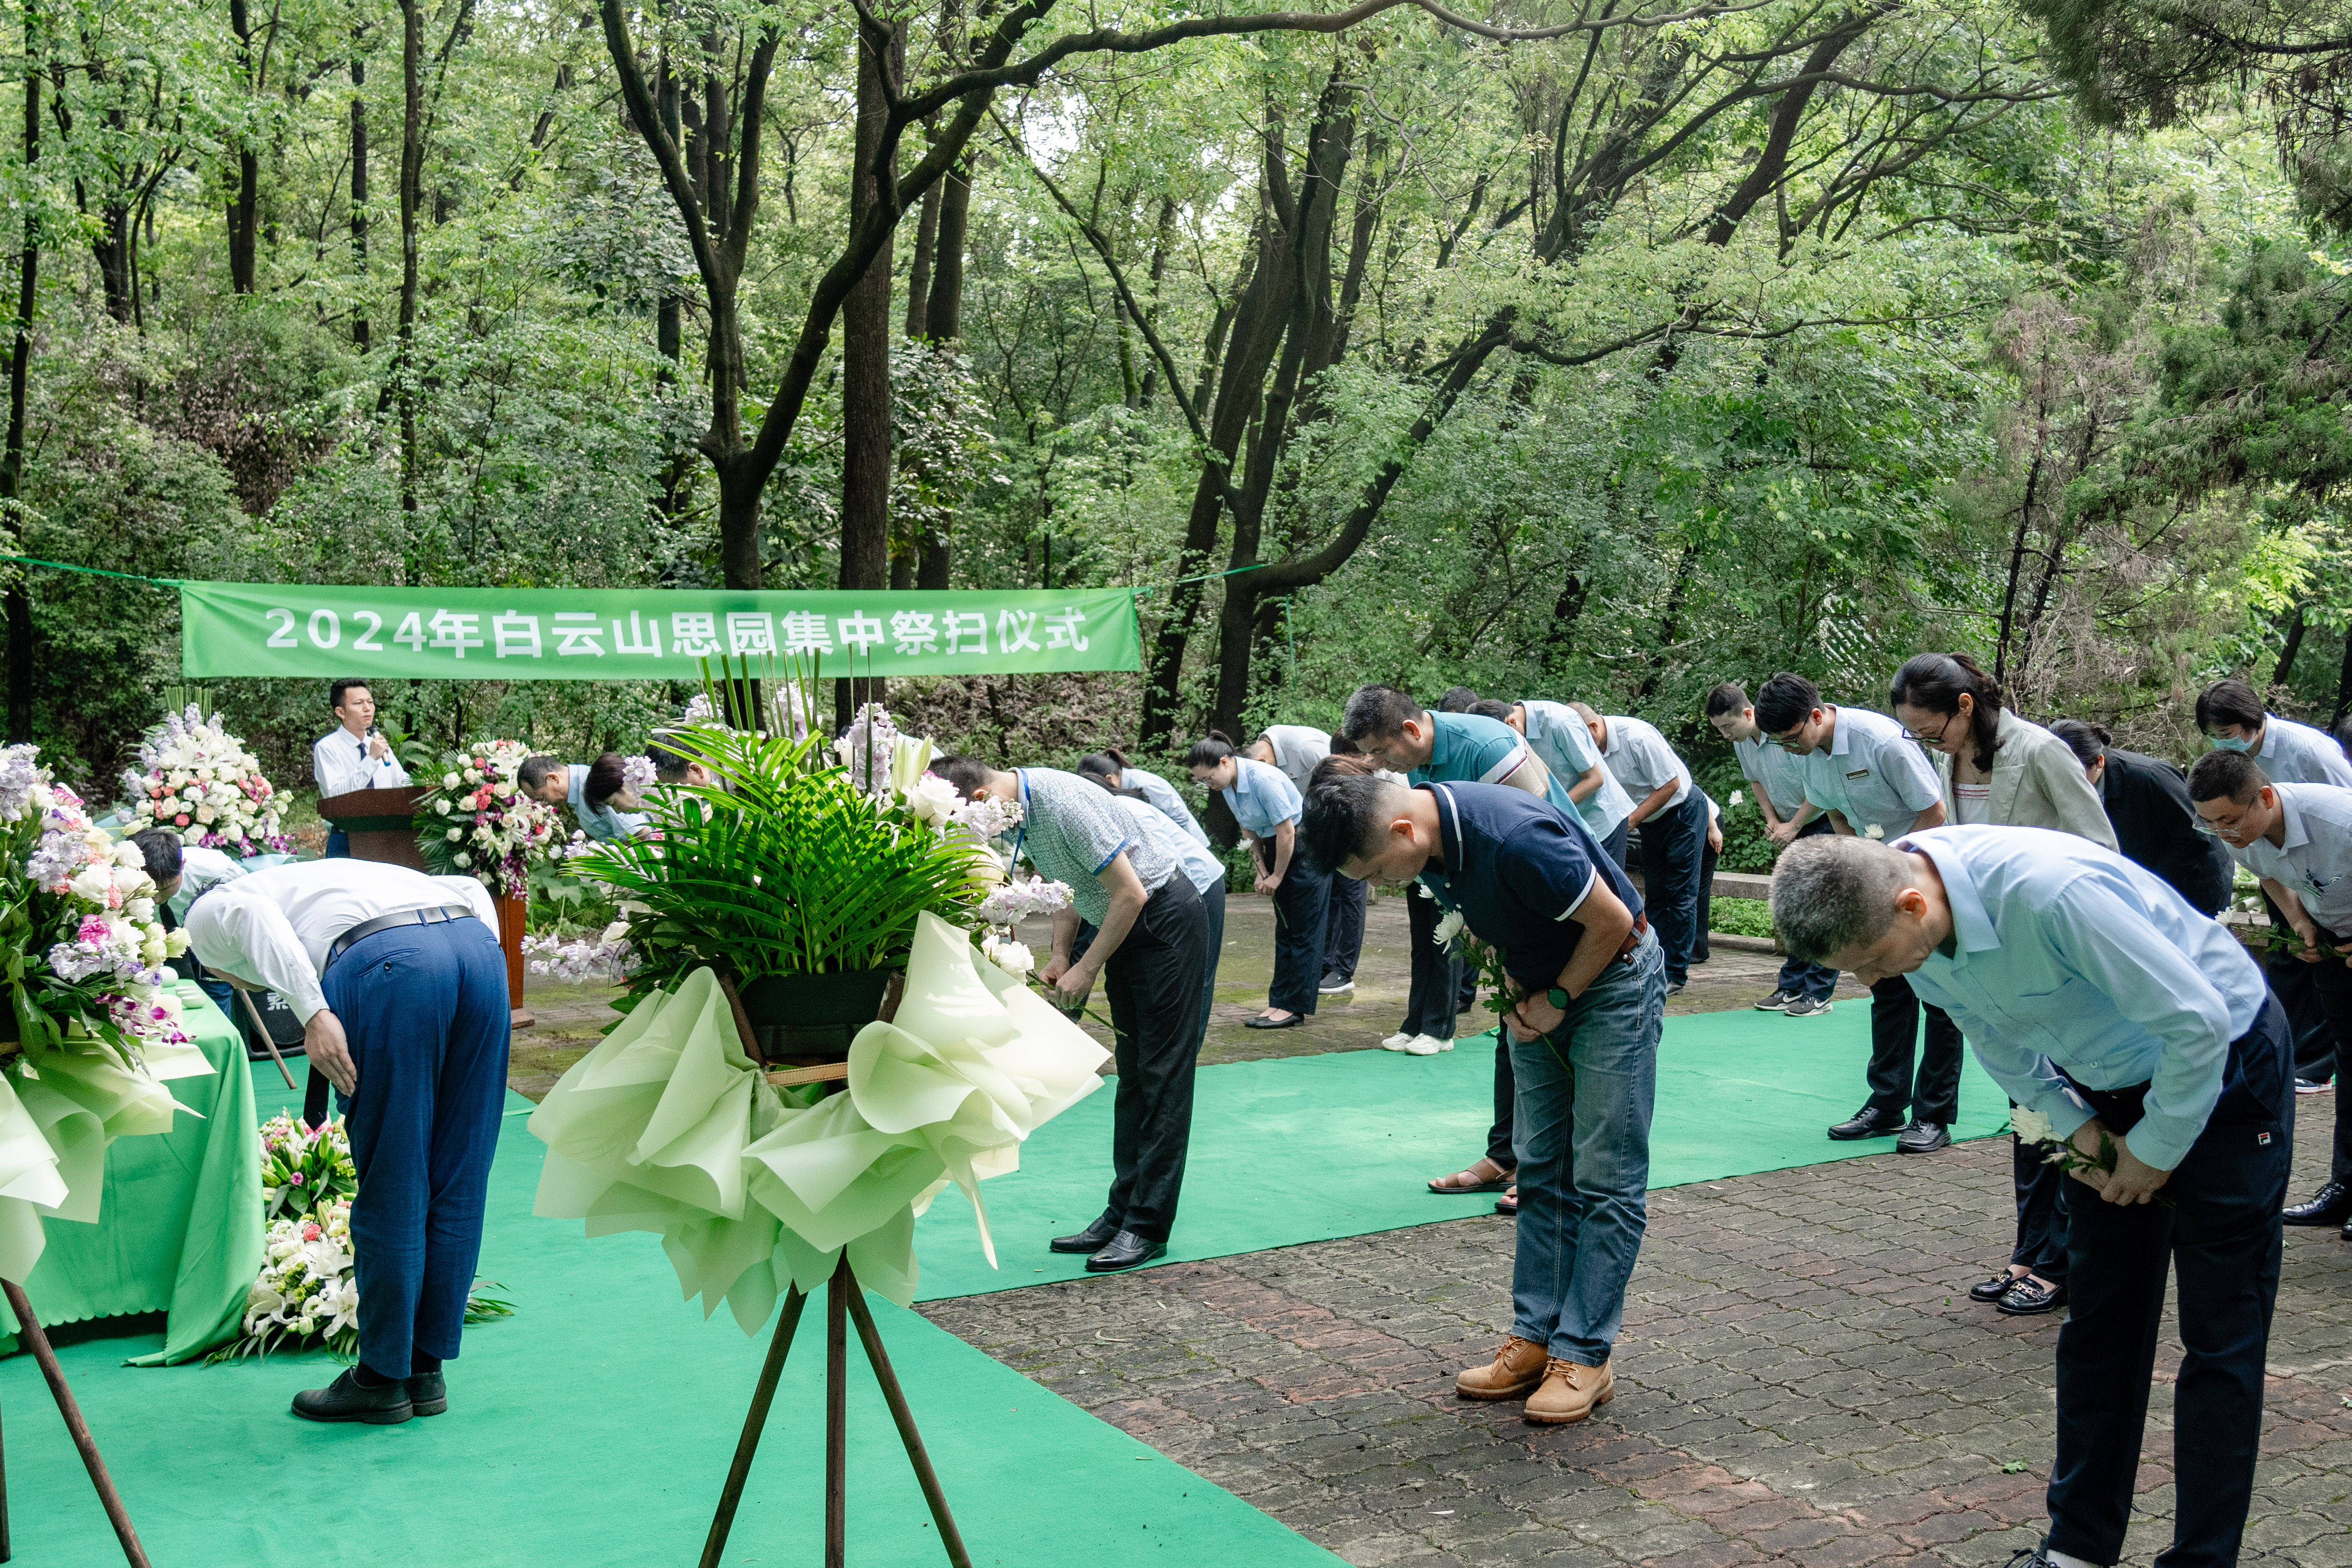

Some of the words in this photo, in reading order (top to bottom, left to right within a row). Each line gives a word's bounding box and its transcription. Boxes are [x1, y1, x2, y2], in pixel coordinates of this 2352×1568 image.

[265, 606, 1089, 658] 2024年白云山思园集中祭扫仪式
